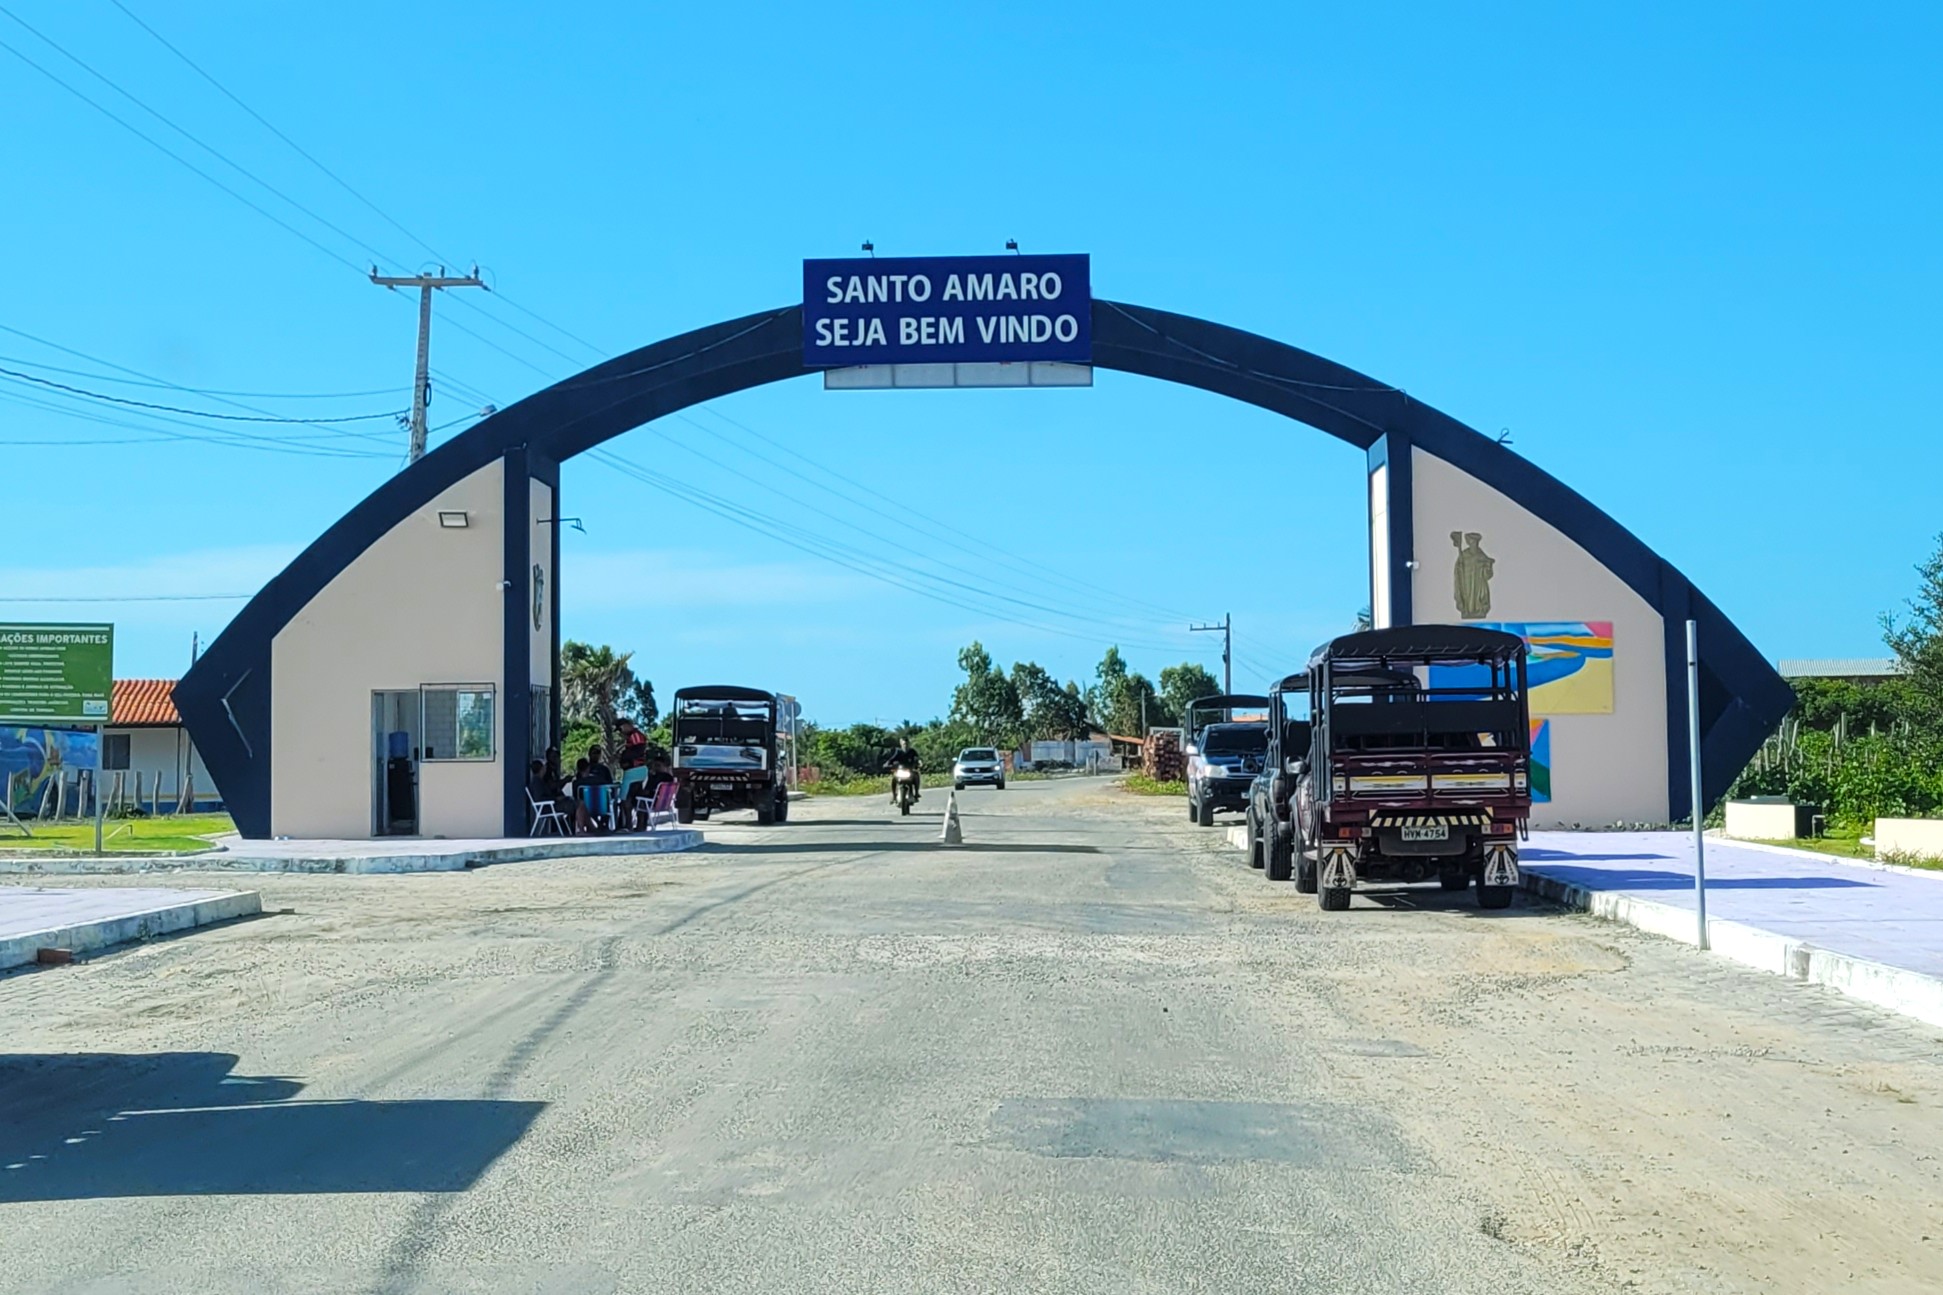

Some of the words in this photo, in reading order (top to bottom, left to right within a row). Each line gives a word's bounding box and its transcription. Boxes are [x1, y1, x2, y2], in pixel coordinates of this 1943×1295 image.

[826, 275, 932, 304] SANTO
[942, 272, 1062, 301] AMARO
[815, 318, 887, 346] SEJA
[899, 316, 965, 345] BEM
[976, 314, 1079, 343] VINDO
[0, 632, 34, 645] AÇÕES
[36, 634, 108, 644] IMPORTANTES
